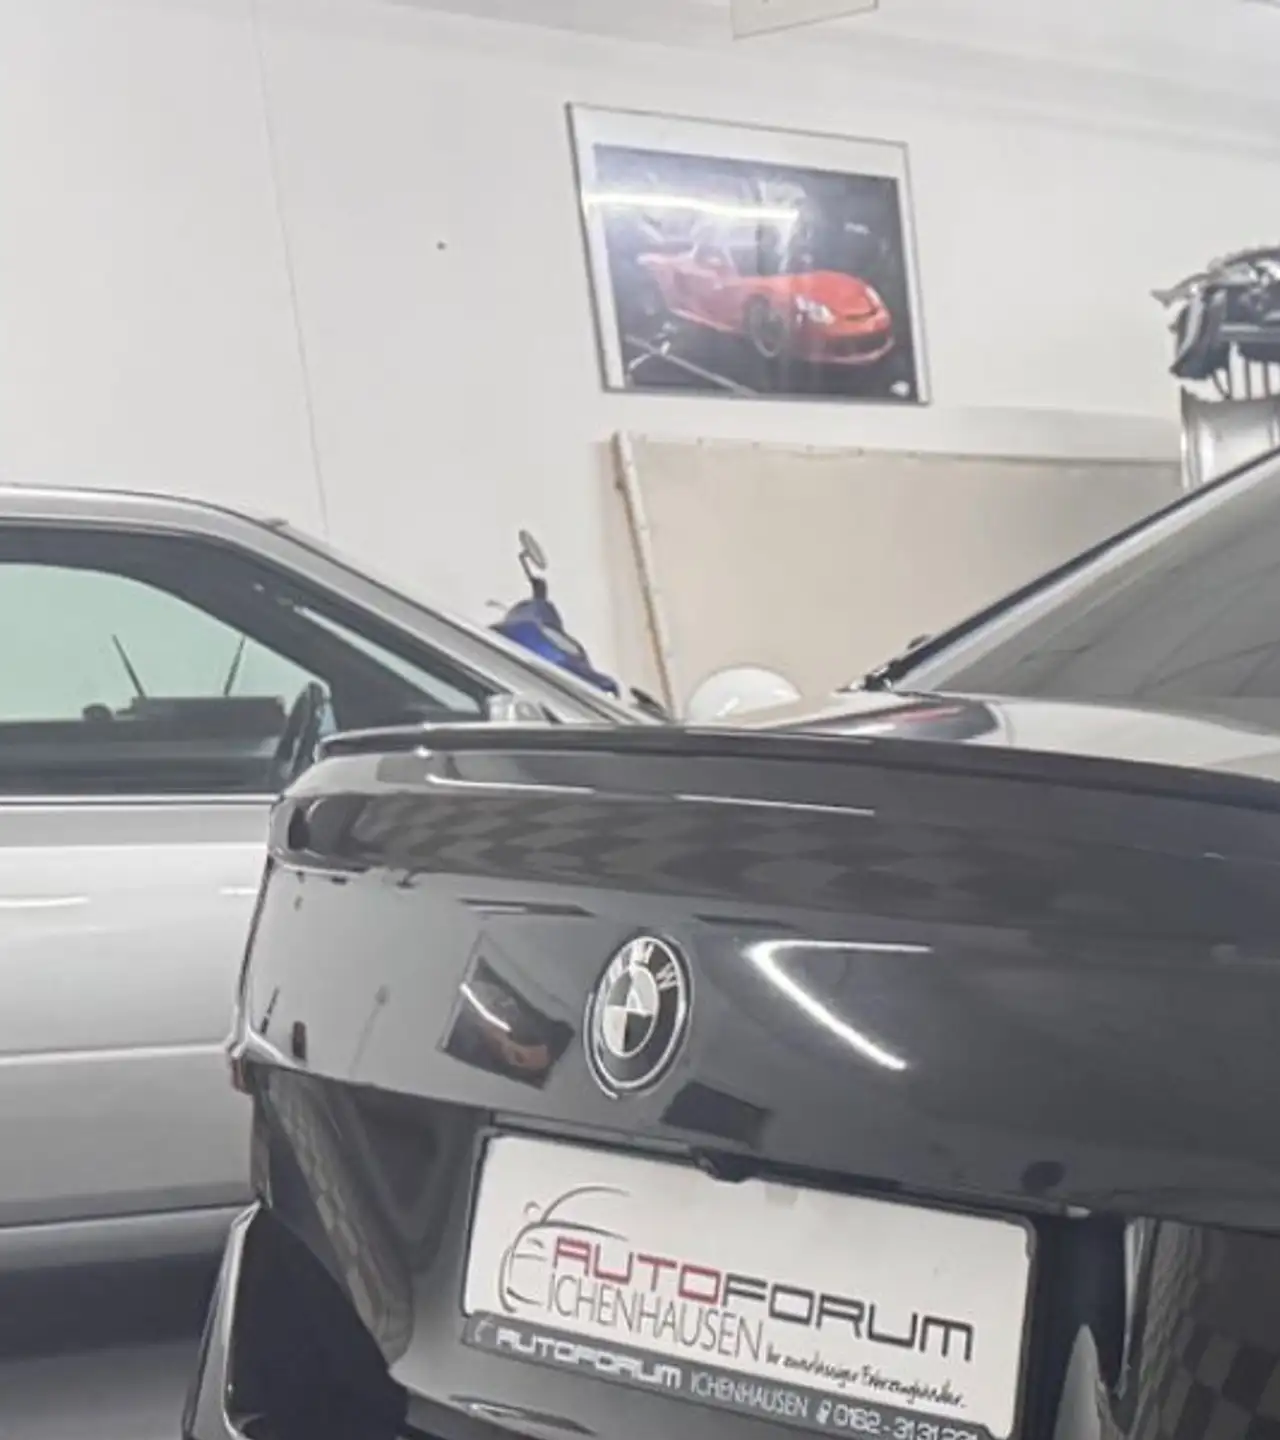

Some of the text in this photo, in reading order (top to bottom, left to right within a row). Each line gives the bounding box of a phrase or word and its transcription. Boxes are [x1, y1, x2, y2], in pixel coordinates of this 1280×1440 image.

[547, 1273, 764, 1361] ICHENHAUSEN
[553, 1236, 974, 1362] AUTOFORUM
[496, 1327, 681, 1389] AUTOFORUM
[691, 1371, 807, 1417] ICHENHAUSEN
